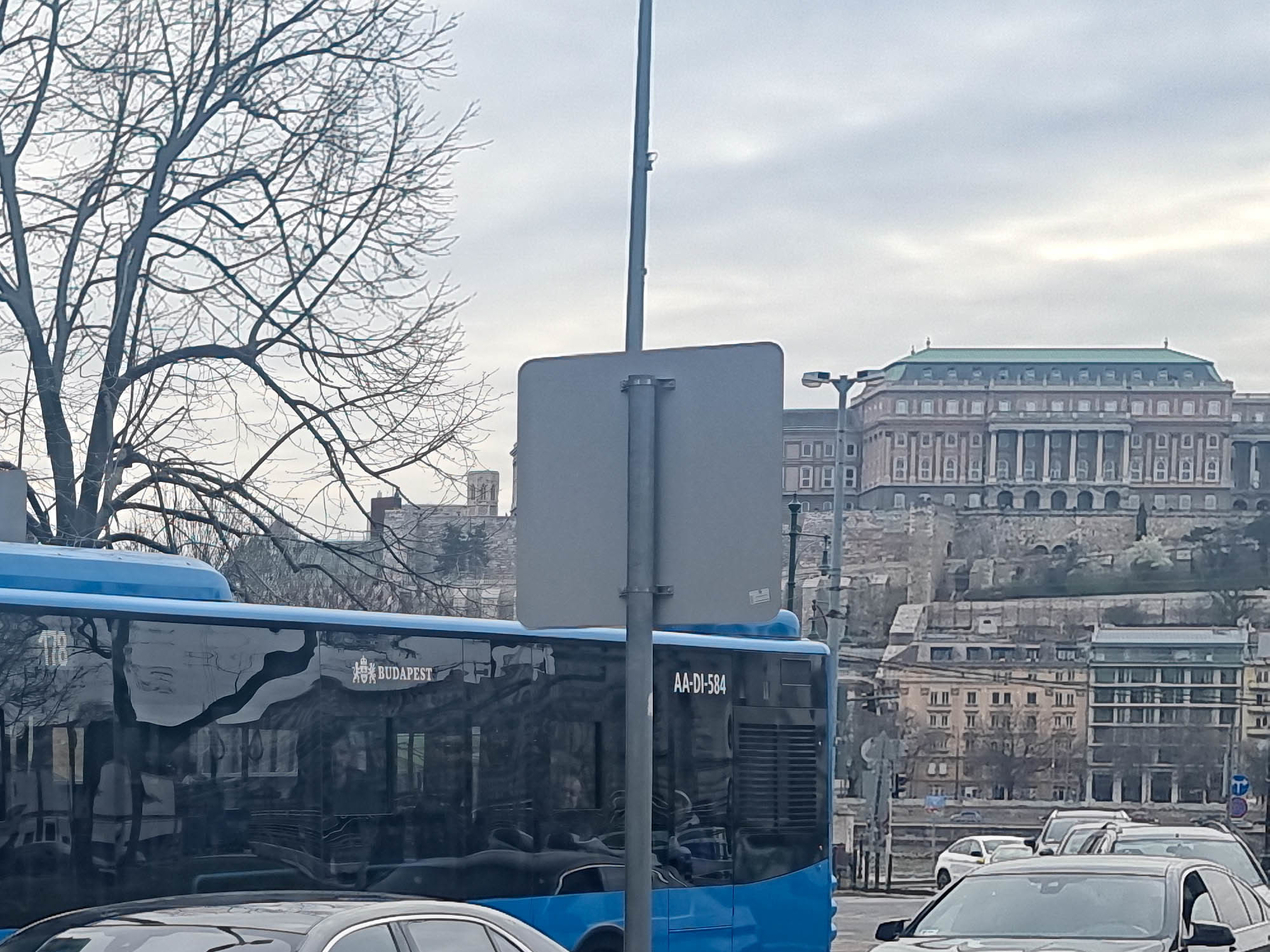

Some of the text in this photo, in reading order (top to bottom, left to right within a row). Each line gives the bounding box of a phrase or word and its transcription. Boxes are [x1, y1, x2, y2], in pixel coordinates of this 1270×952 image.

[38, 630, 68, 666] 178
[378, 665, 433, 682] BUDAPEST
[674, 671, 726, 695] AA-DI-584
